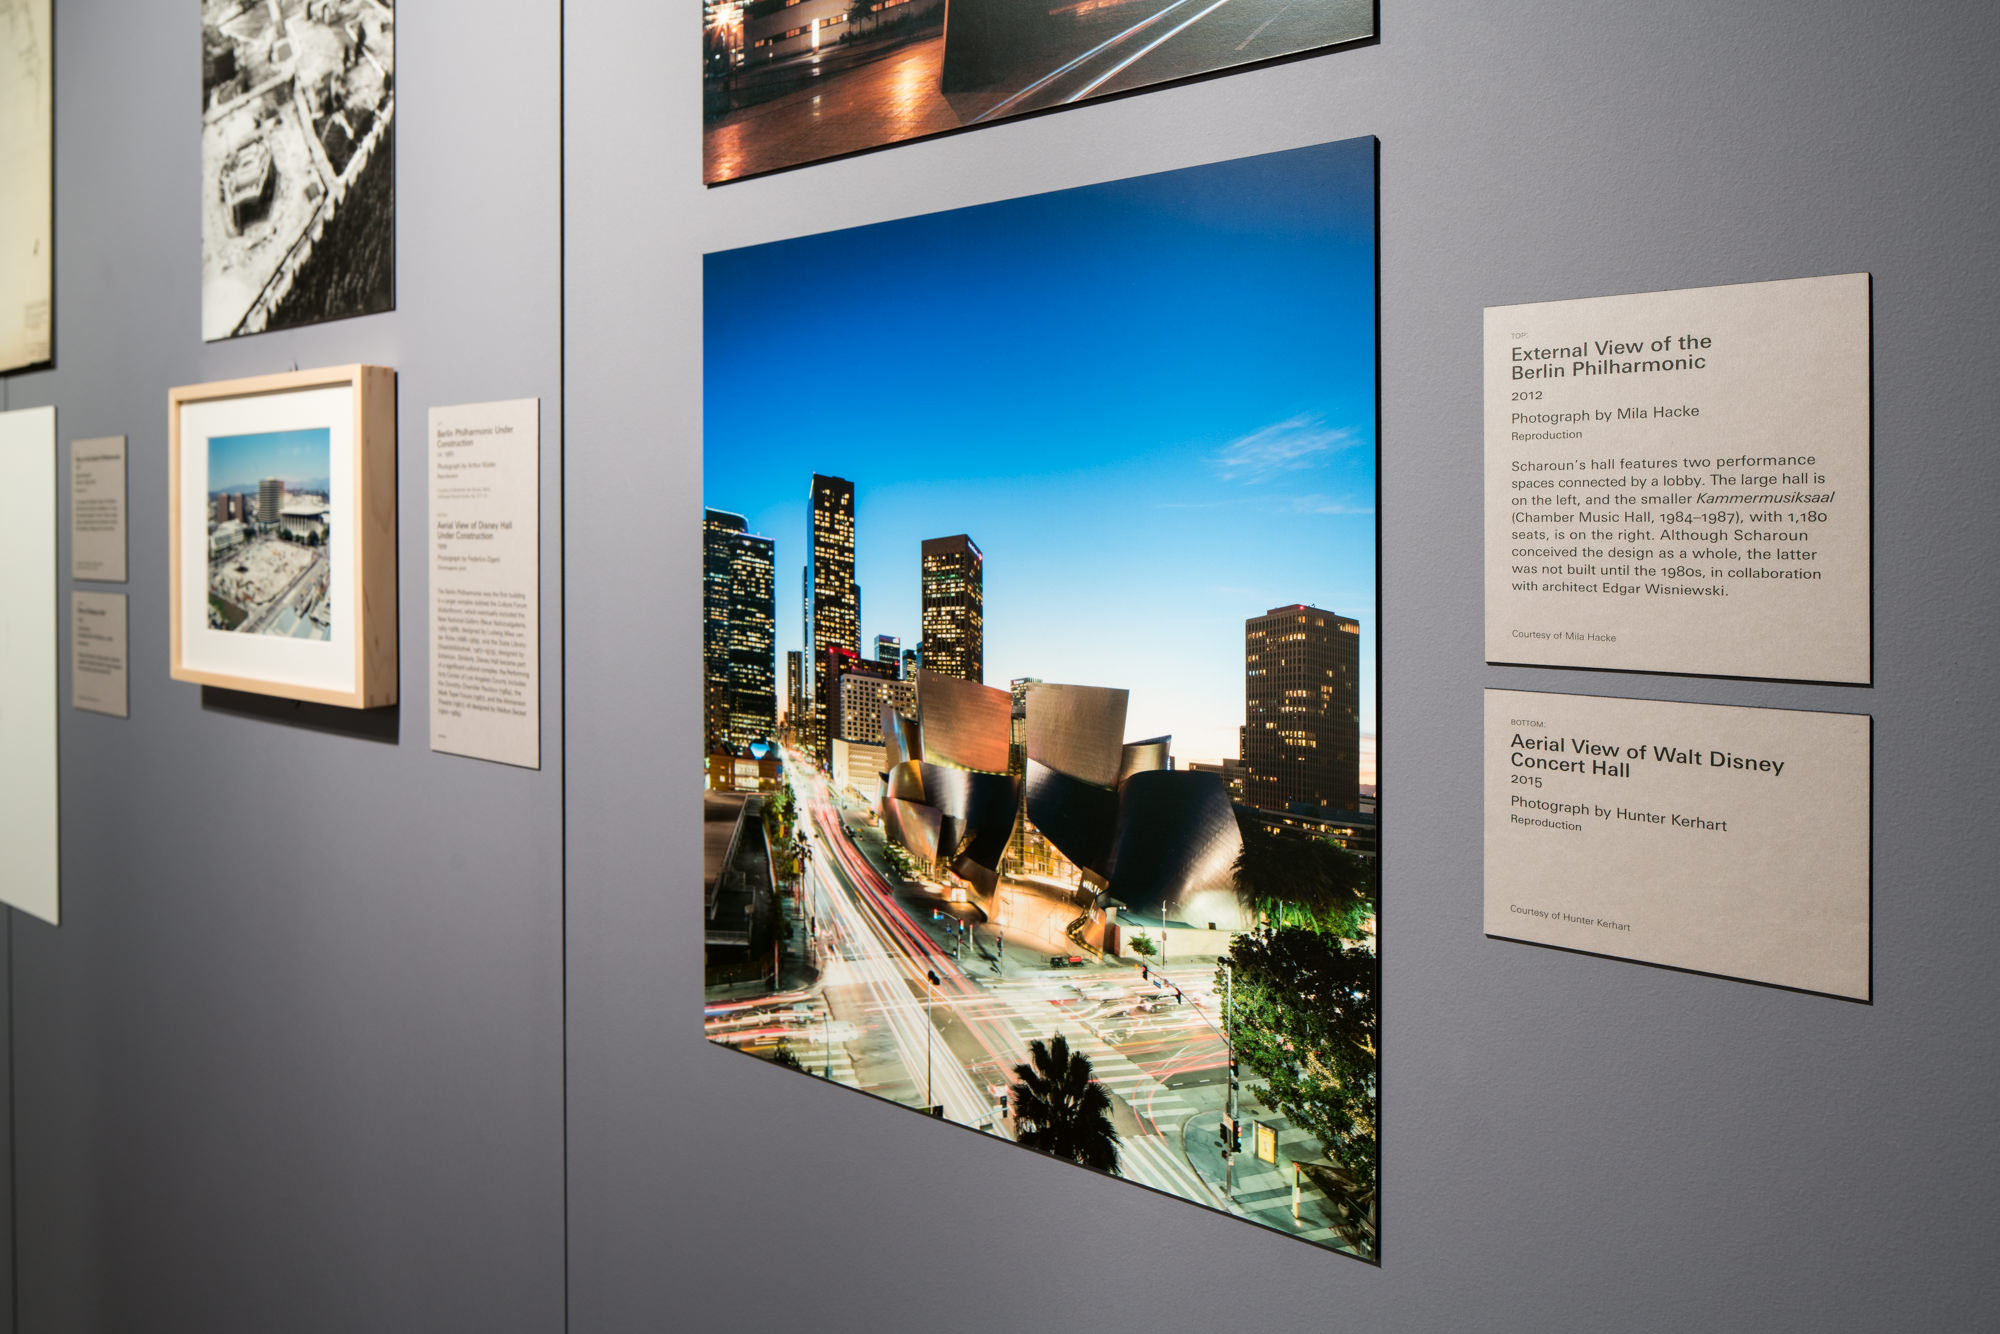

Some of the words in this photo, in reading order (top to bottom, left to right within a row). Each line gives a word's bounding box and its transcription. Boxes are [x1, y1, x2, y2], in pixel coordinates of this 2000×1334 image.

[1512, 342, 1588, 362] External
[1594, 340, 1644, 356] View
[1651, 336, 1672, 352] of
[1678, 334, 1712, 350] the
[1512, 364, 1564, 380] Berlin
[1573, 354, 1706, 376] Philharmonic
[1512, 391, 1542, 401] 2012
[1512, 410, 1590, 425] Photograph
[1596, 409, 1612, 422] by
[1618, 408, 1648, 420] Mila
[1654, 405, 1699, 418] Hacke
[1512, 430, 1582, 442] Reproduction
[1591, 459, 1614, 470] hall
[1620, 458, 1678, 470] features
[1682, 458, 1710, 468] two
[1716, 455, 1816, 470] performance
[1512, 480, 1556, 490] spaces
[1558, 476, 1626, 488] connected
[1630, 476, 1647, 489] by
[1651, 478, 1658, 486] a
[1664, 474, 1705, 488] lobby.
[1709, 474, 1736, 486] The
[1740, 474, 1778, 488] large
[1782, 472, 1808, 484] hall
[1814, 473, 1825, 484] is
[1512, 497, 1527, 506] on
[1531, 494, 1552, 506] the
[1556, 494, 1580, 507] left,
[1585, 494, 1610, 506] and
[1614, 493, 1637, 504] the
[1641, 493, 1692, 504] smaller
[1696, 491, 1835, 504] Kammermusiksaal
[1512, 512, 1576, 524] (Chamber
[1579, 512, 1621, 523] Music
[1625, 511, 1654, 524] Hall,
[1749, 510, 1782, 522] with
[1786, 510, 1827, 524] 1,180
[437, 521, 453, 529] Aerial
[455, 521, 469, 529] View
[1512, 530, 1549, 541] seats,
[1555, 530, 1565, 540] is
[1569, 531, 1586, 540] on
[1591, 529, 1615, 540] the
[1618, 529, 1654, 543] right.
[1660, 529, 1728, 543] Although
[1734, 529, 1808, 542] Scharoun
[1512, 546, 1577, 558] conceived
[1582, 546, 1606, 558] the
[1608, 546, 1655, 561] design
[1658, 549, 1674, 559] as
[1678, 550, 1689, 559] a
[1692, 548, 1741, 561] whole,
[1746, 548, 1772, 560] the
[1776, 548, 1818, 560] latter
[1512, 566, 1538, 574] was
[1542, 564, 1563, 575] not
[1568, 564, 1596, 575] built
[1601, 565, 1630, 576] until
[1634, 565, 1656, 576] the
[1660, 566, 1706, 579] 1980s,
[1711, 568, 1724, 578] in
[1728, 568, 1821, 580] collaboration
[1512, 581, 1538, 591] with
[1542, 581, 1598, 592] architect
[1602, 582, 1640, 596] Edgar
[1645, 584, 1728, 596] Wisniewski.
[1512, 630, 1551, 640] Courtesy
[1554, 632, 1562, 640] of
[1566, 632, 1584, 640] Mila
[1588, 633, 1616, 642] Hacke
[1510, 719, 1546, 728] BOTTOM:
[1510, 734, 1564, 752] Aerial
[1570, 738, 1620, 757] View
[1626, 745, 1647, 760] of
[1653, 746, 1702, 766] Walt
[1710, 751, 1784, 776] Disney
[1511, 752, 1585, 774] Concert
[1593, 760, 1629, 778] Hall
[1511, 774, 1542, 788] 2015
[1512, 795, 1589, 816] Photograph
[1595, 804, 1611, 820] by
[1617, 808, 1666, 824] Hunter
[1672, 814, 1727, 832] Kerhart
[1511, 814, 1582, 831] Reproduction
[1510, 904, 1549, 920] Courtesy
[1550, 912, 1560, 920] of
[1563, 913, 1596, 926] Hunter
[1597, 918, 1630, 932] Kerhart
